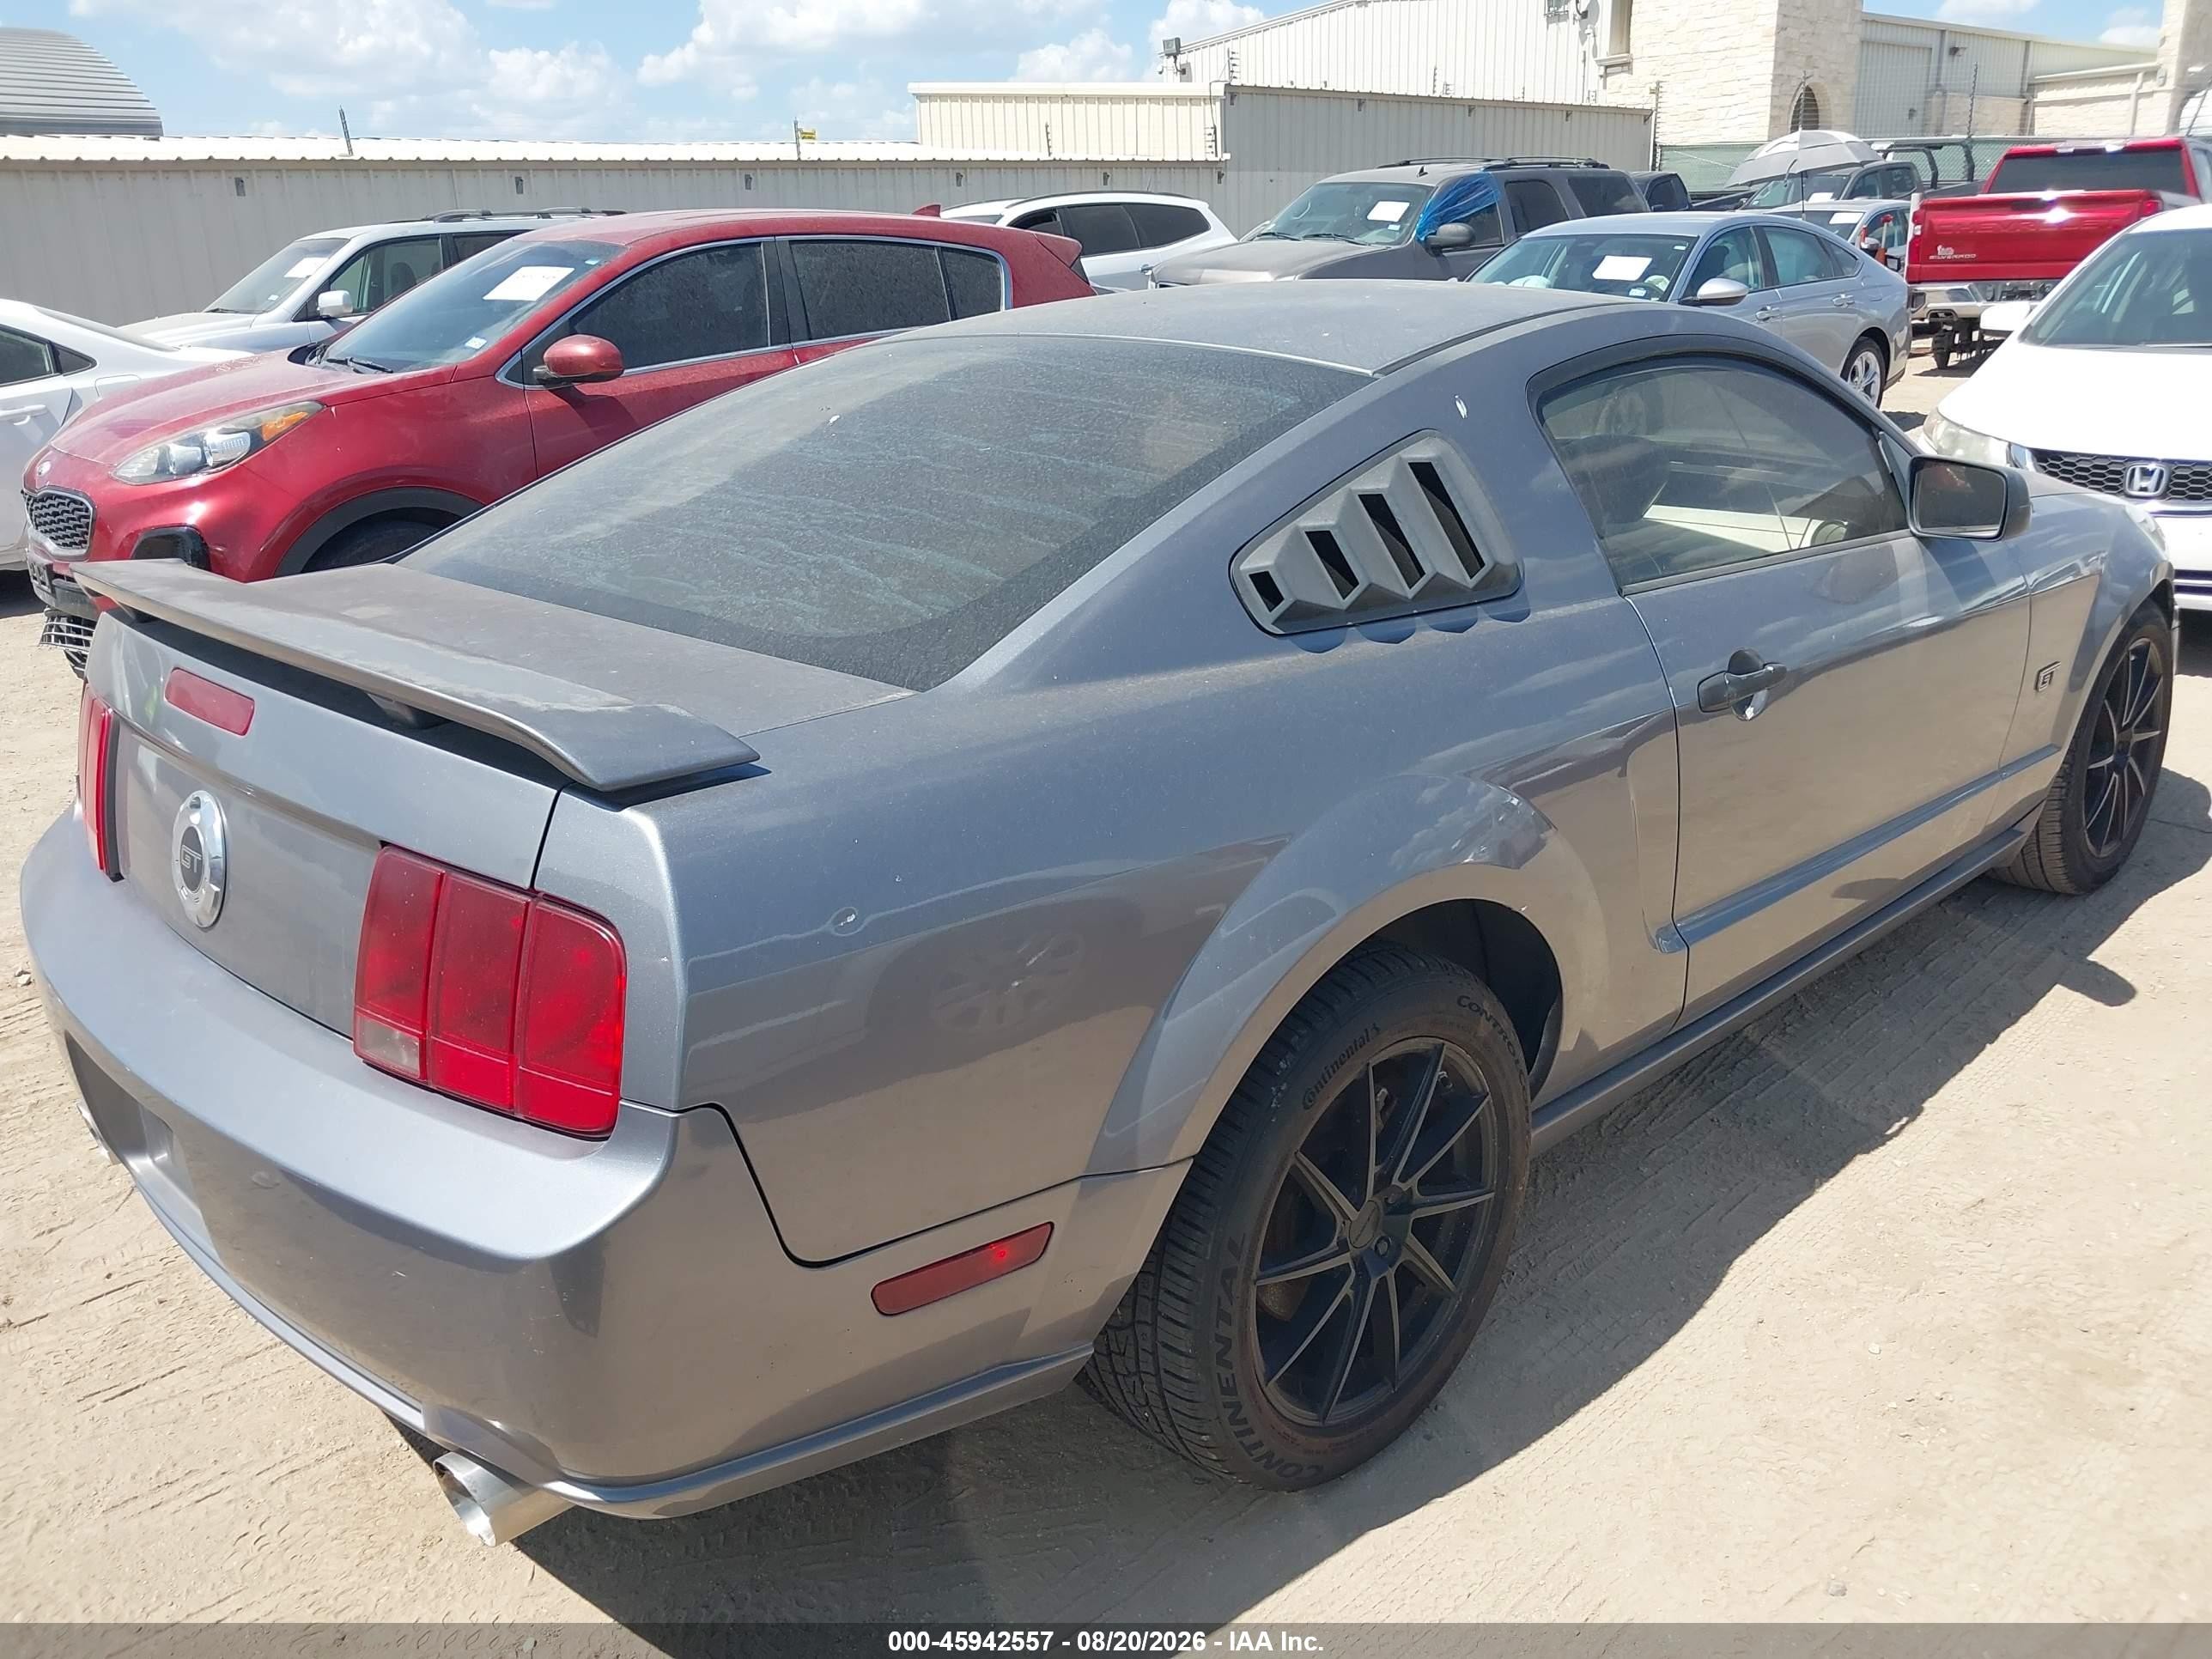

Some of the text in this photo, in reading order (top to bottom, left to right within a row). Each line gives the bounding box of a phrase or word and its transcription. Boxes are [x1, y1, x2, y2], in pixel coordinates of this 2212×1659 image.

[2033, 660, 2062, 692] GT
[180, 844, 203, 873] GT
[1302, 1027, 1371, 1111] Continental
[1214, 1232, 1324, 1480] CONTINENTAL
